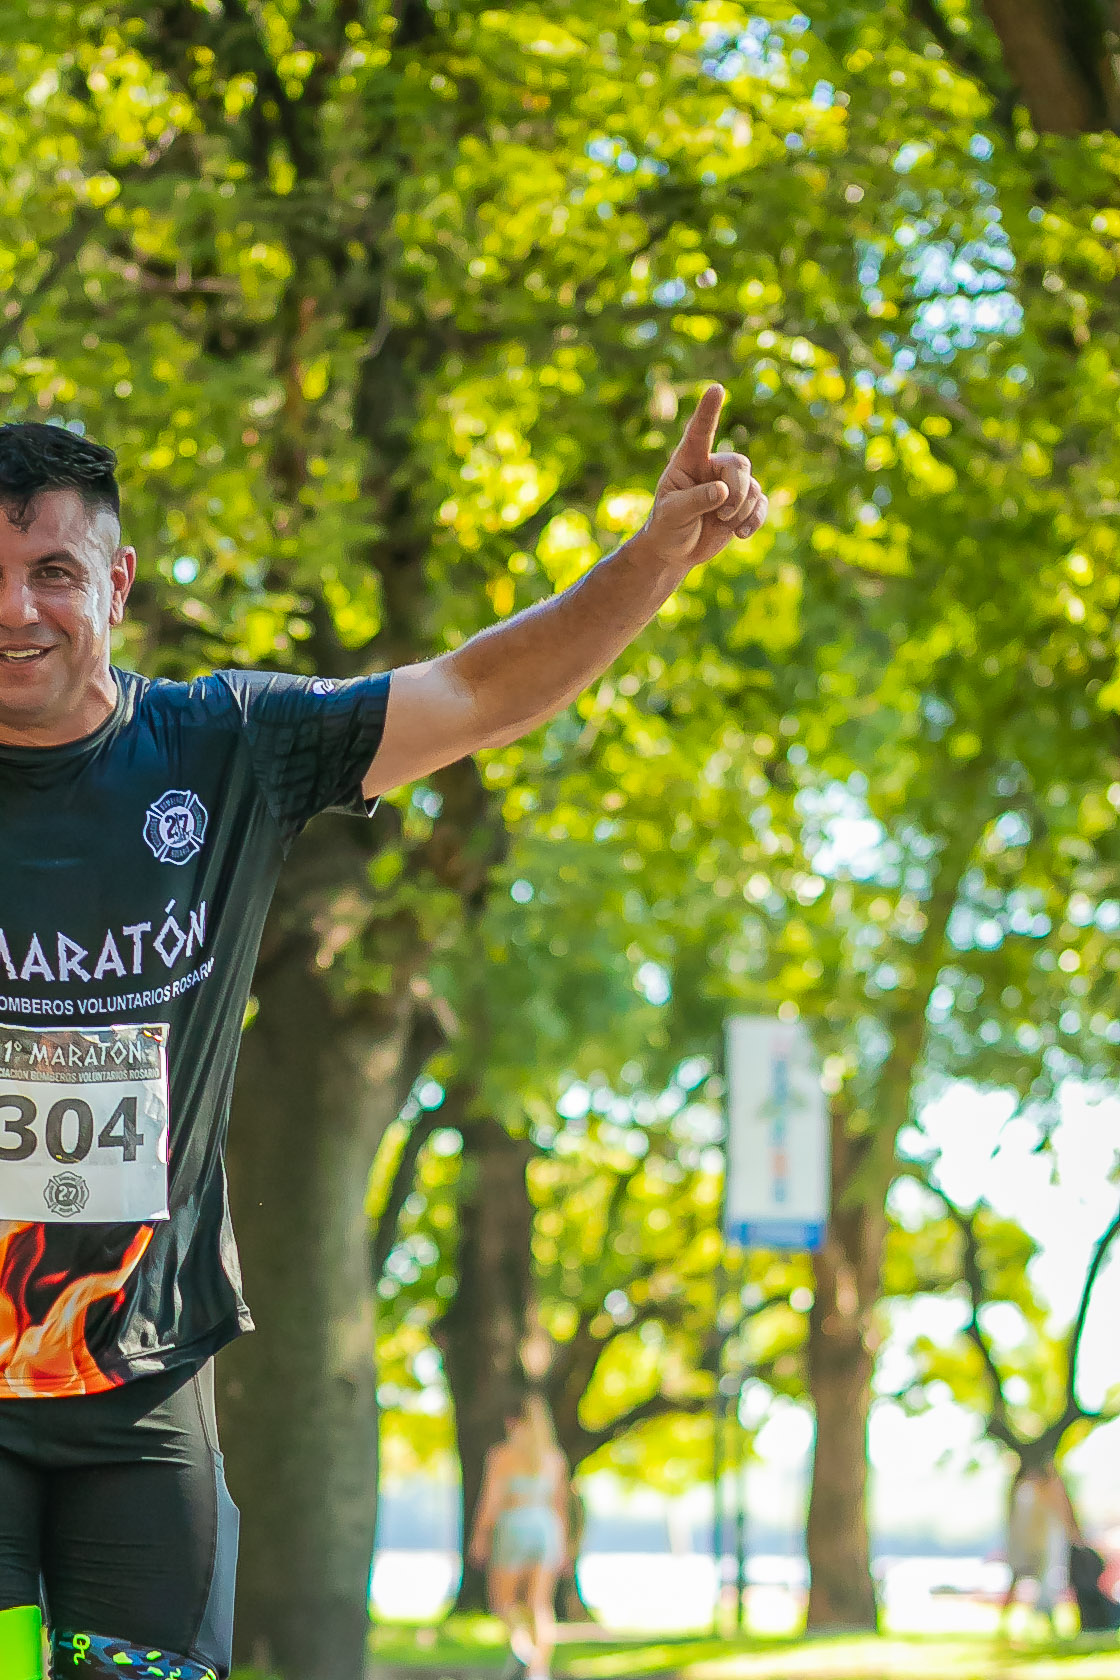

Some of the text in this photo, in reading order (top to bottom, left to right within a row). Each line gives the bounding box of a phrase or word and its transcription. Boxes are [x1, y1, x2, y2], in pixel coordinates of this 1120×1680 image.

[165, 812, 189, 841] 27
[77, 983, 172, 1015] VOLUNTARIOS
[30, 1070, 77, 1083] BOMBEROS
[78, 1069, 128, 1083] VOLUNTARIOS
[129, 1067, 160, 1080] ROSARIO
[57, 1185, 77, 1201] 27
